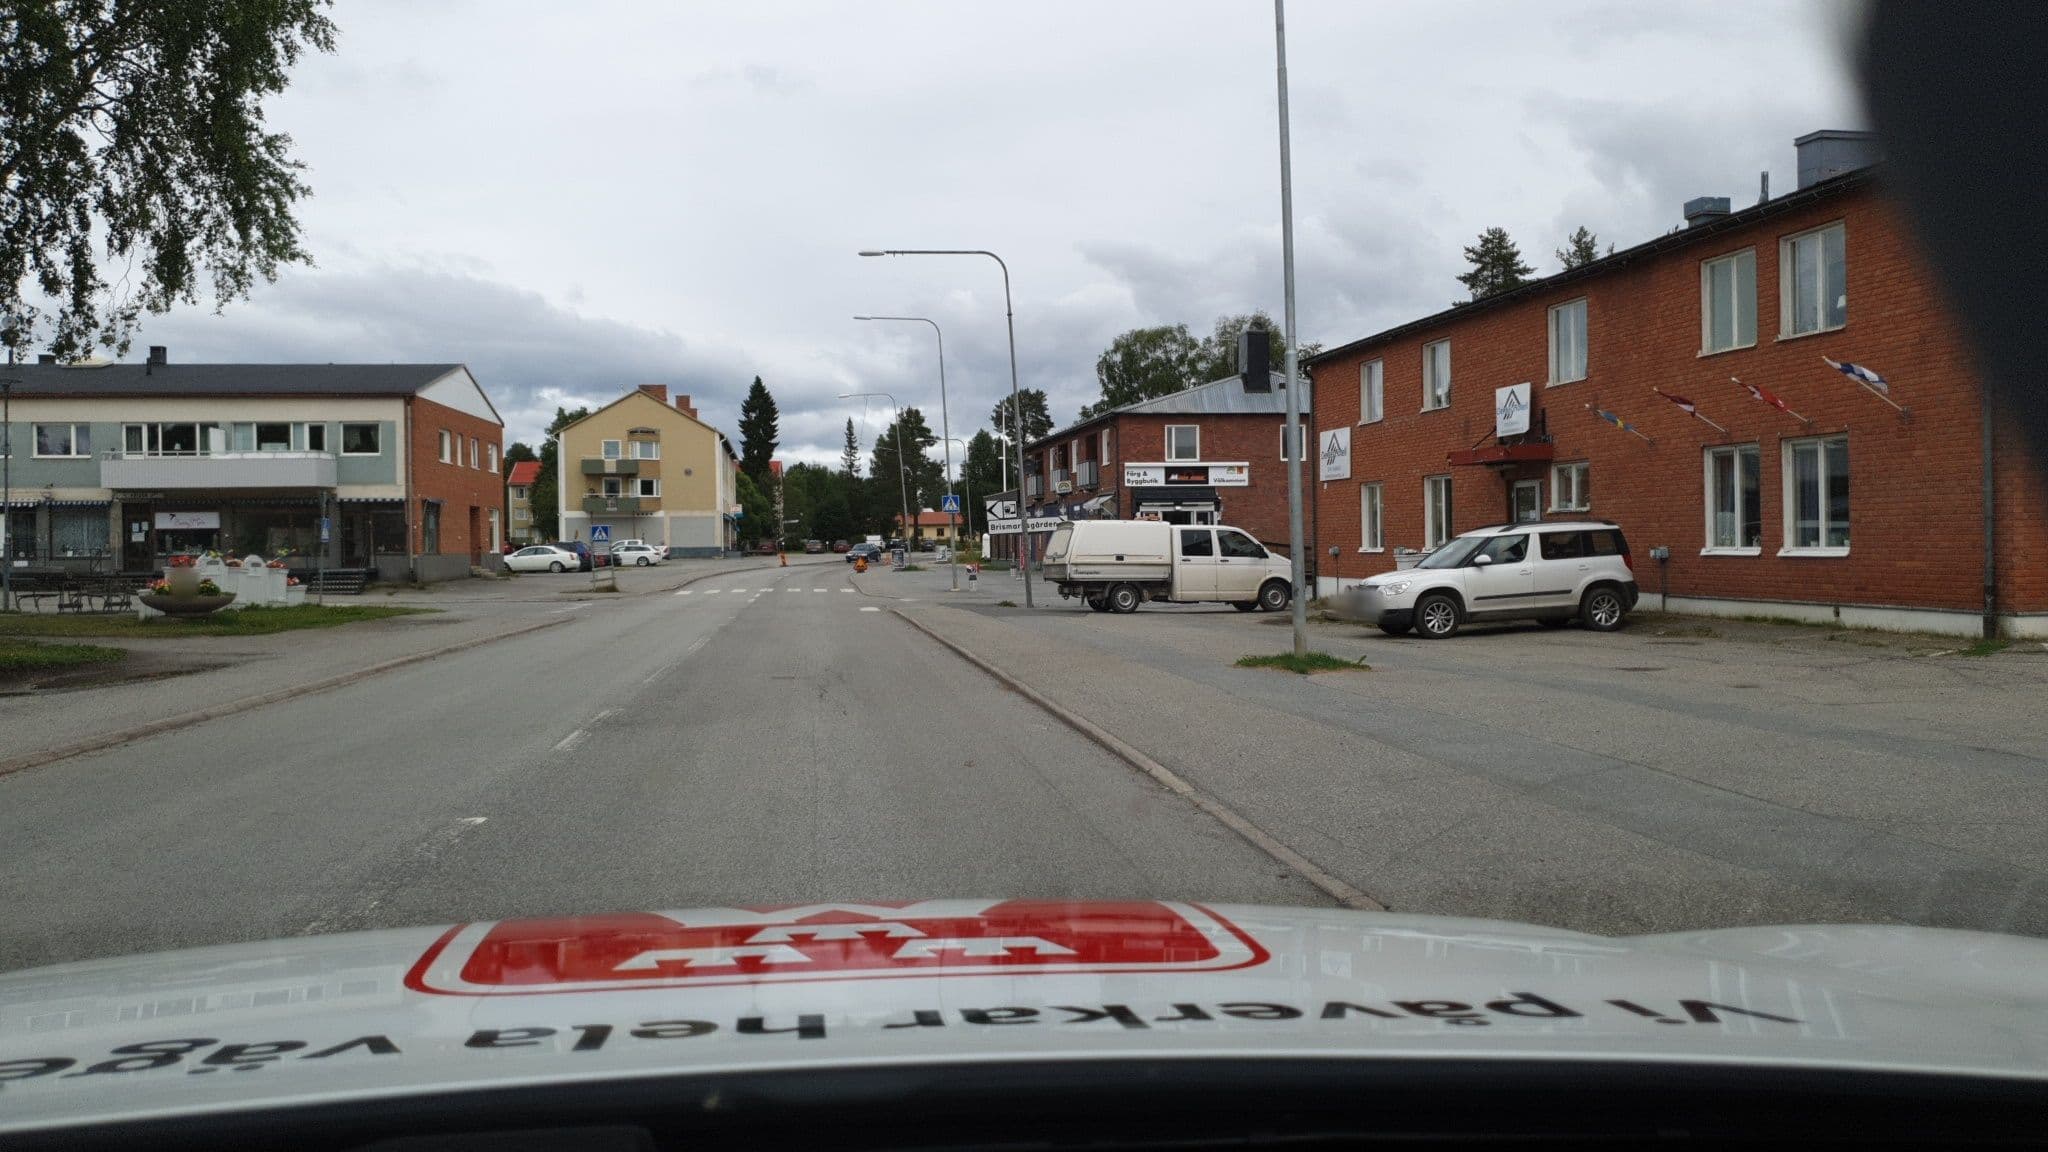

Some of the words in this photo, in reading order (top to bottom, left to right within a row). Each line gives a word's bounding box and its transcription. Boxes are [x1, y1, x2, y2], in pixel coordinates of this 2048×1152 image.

[882, 992, 1584, 1029] påverkar
[1604, 999, 1806, 1024] Vi
[463, 1013, 826, 1051] hela
[0, 1035, 402, 1088] väge
